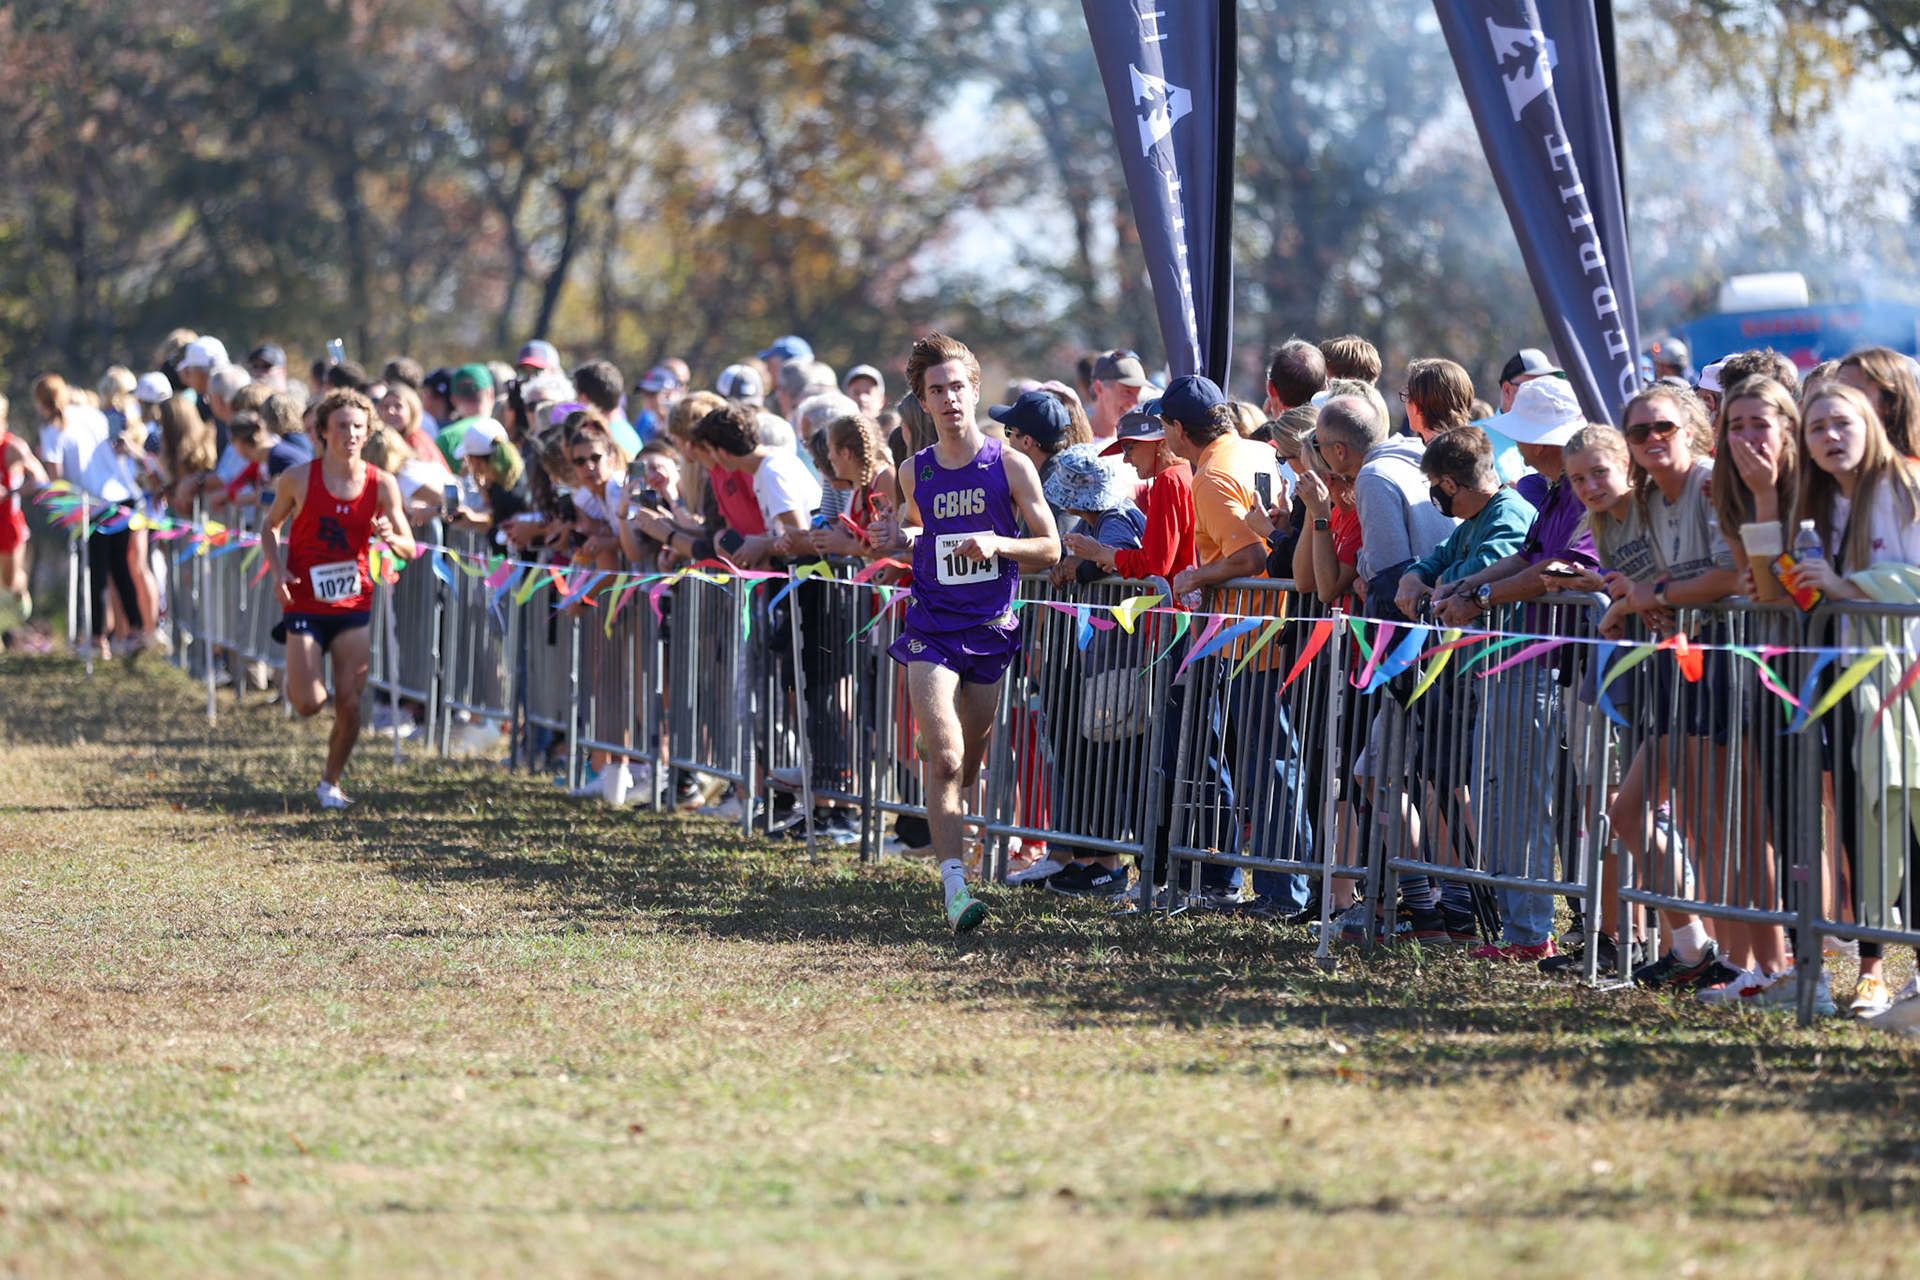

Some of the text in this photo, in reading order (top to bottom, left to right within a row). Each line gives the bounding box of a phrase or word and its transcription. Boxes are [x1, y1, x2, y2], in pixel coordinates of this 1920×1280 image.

[934, 488, 985, 519] CBHS
[942, 540, 963, 548] TMSA
[319, 576, 356, 598] 1022
[1091, 875, 1113, 887] HOKA
